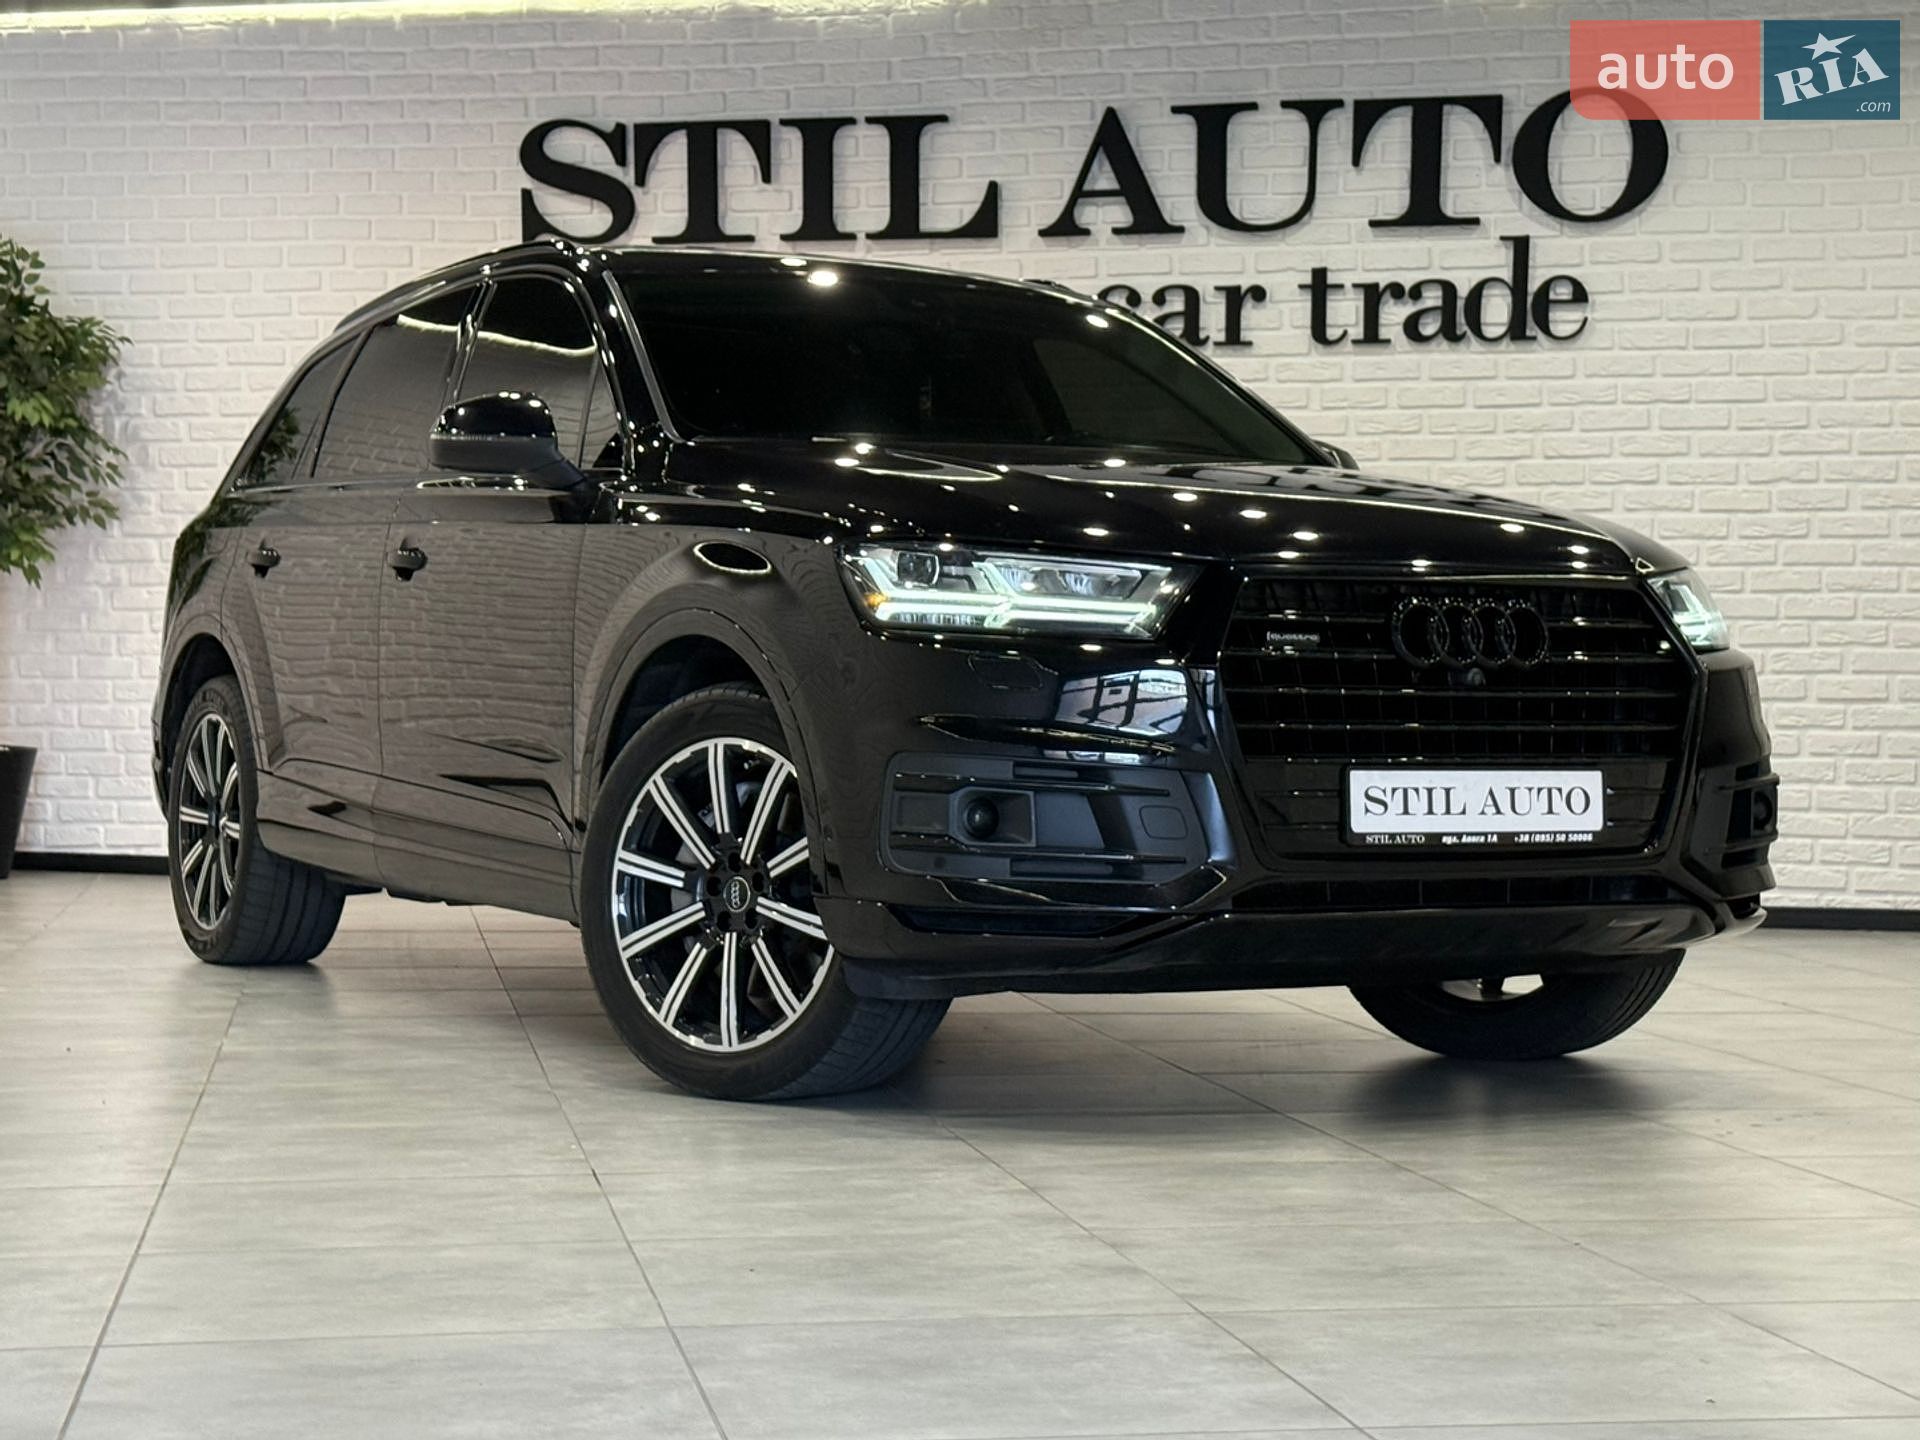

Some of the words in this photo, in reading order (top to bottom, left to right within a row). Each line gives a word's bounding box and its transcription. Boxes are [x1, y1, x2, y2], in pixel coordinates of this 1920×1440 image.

[519, 115, 1000, 243] STIL
[1037, 87, 1669, 237] AUTO
[1297, 235, 1590, 347] trade
[1363, 785, 1467, 817] STIL
[1477, 784, 1592, 817] AUTO
[1366, 834, 1392, 844] STIL
[1394, 834, 1426, 844] AUTO
